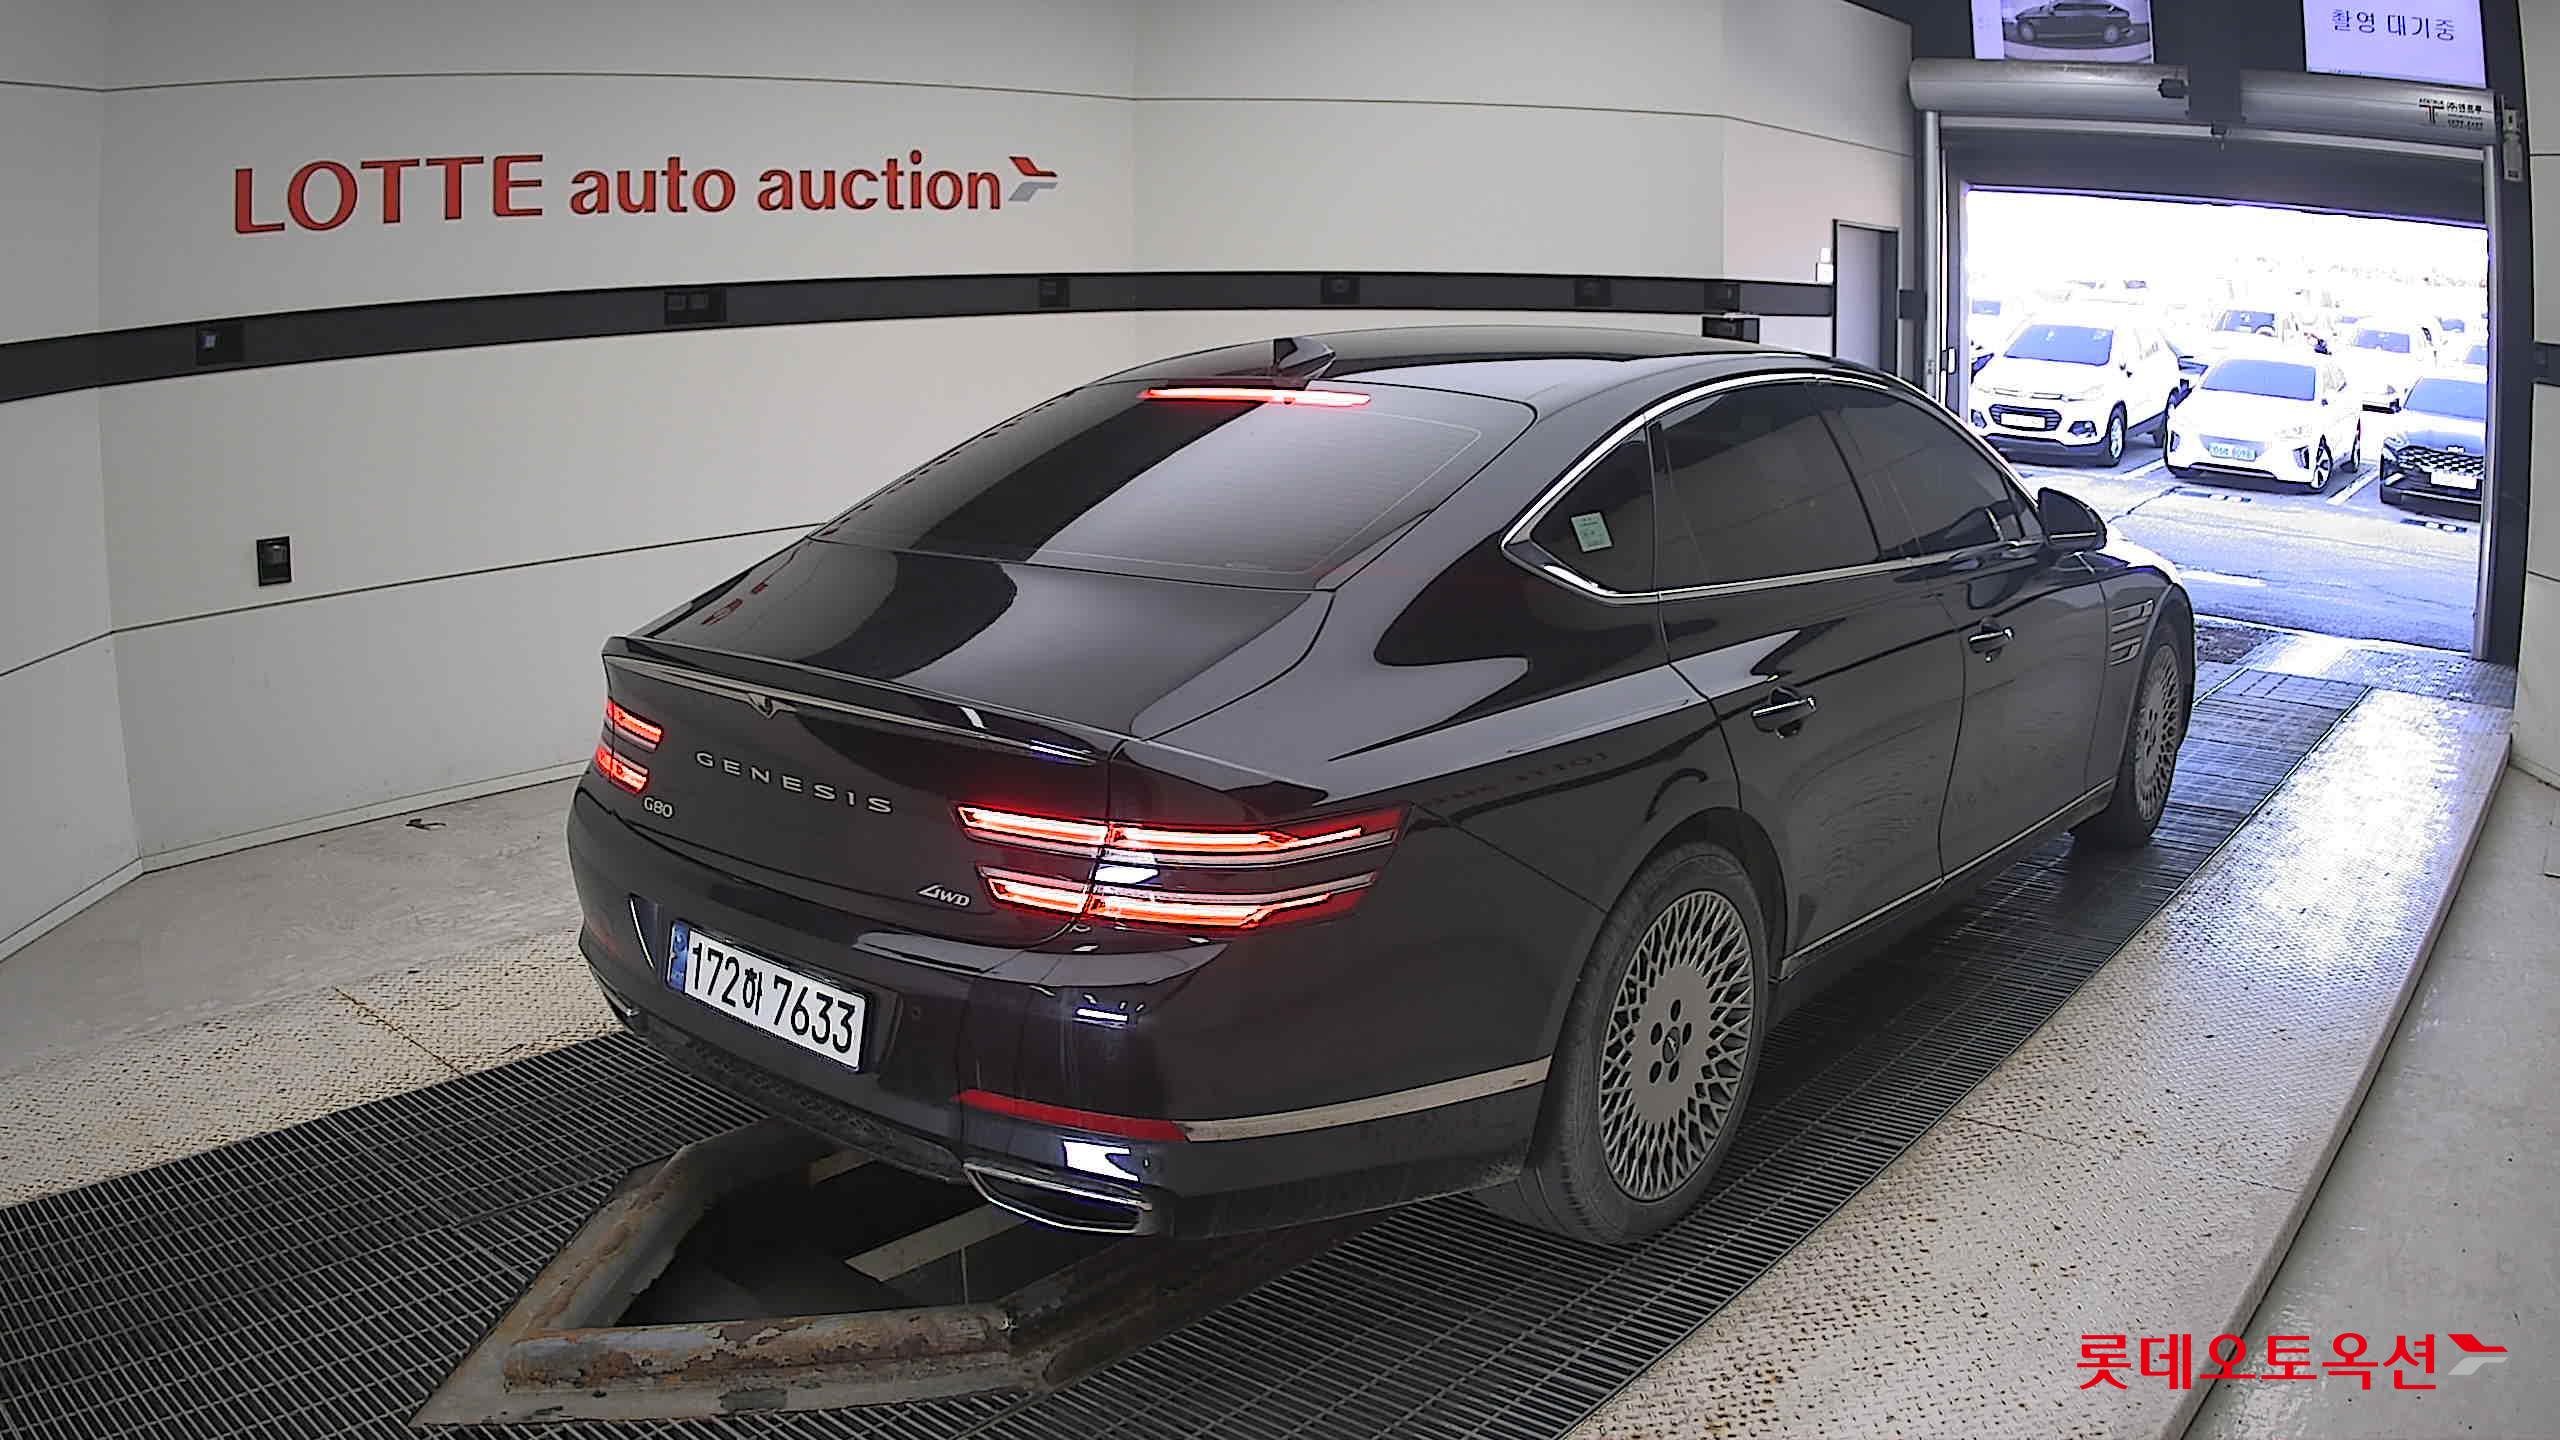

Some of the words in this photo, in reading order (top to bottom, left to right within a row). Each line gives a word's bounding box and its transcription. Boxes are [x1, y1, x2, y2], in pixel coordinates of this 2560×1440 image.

[2331, 9, 2375, 34] 촬영
[2387, 15, 2454, 41] 대기중
[234, 154, 543, 234] LOTTE
[569, 156, 736, 214] auto
[757, 149, 1001, 211] auction
[696, 752, 893, 813] GENESIS
[643, 797, 673, 818] G80
[917, 884, 970, 907] 4WD
[692, 942, 763, 1016] 172하
[773, 975, 855, 1053] 7633
